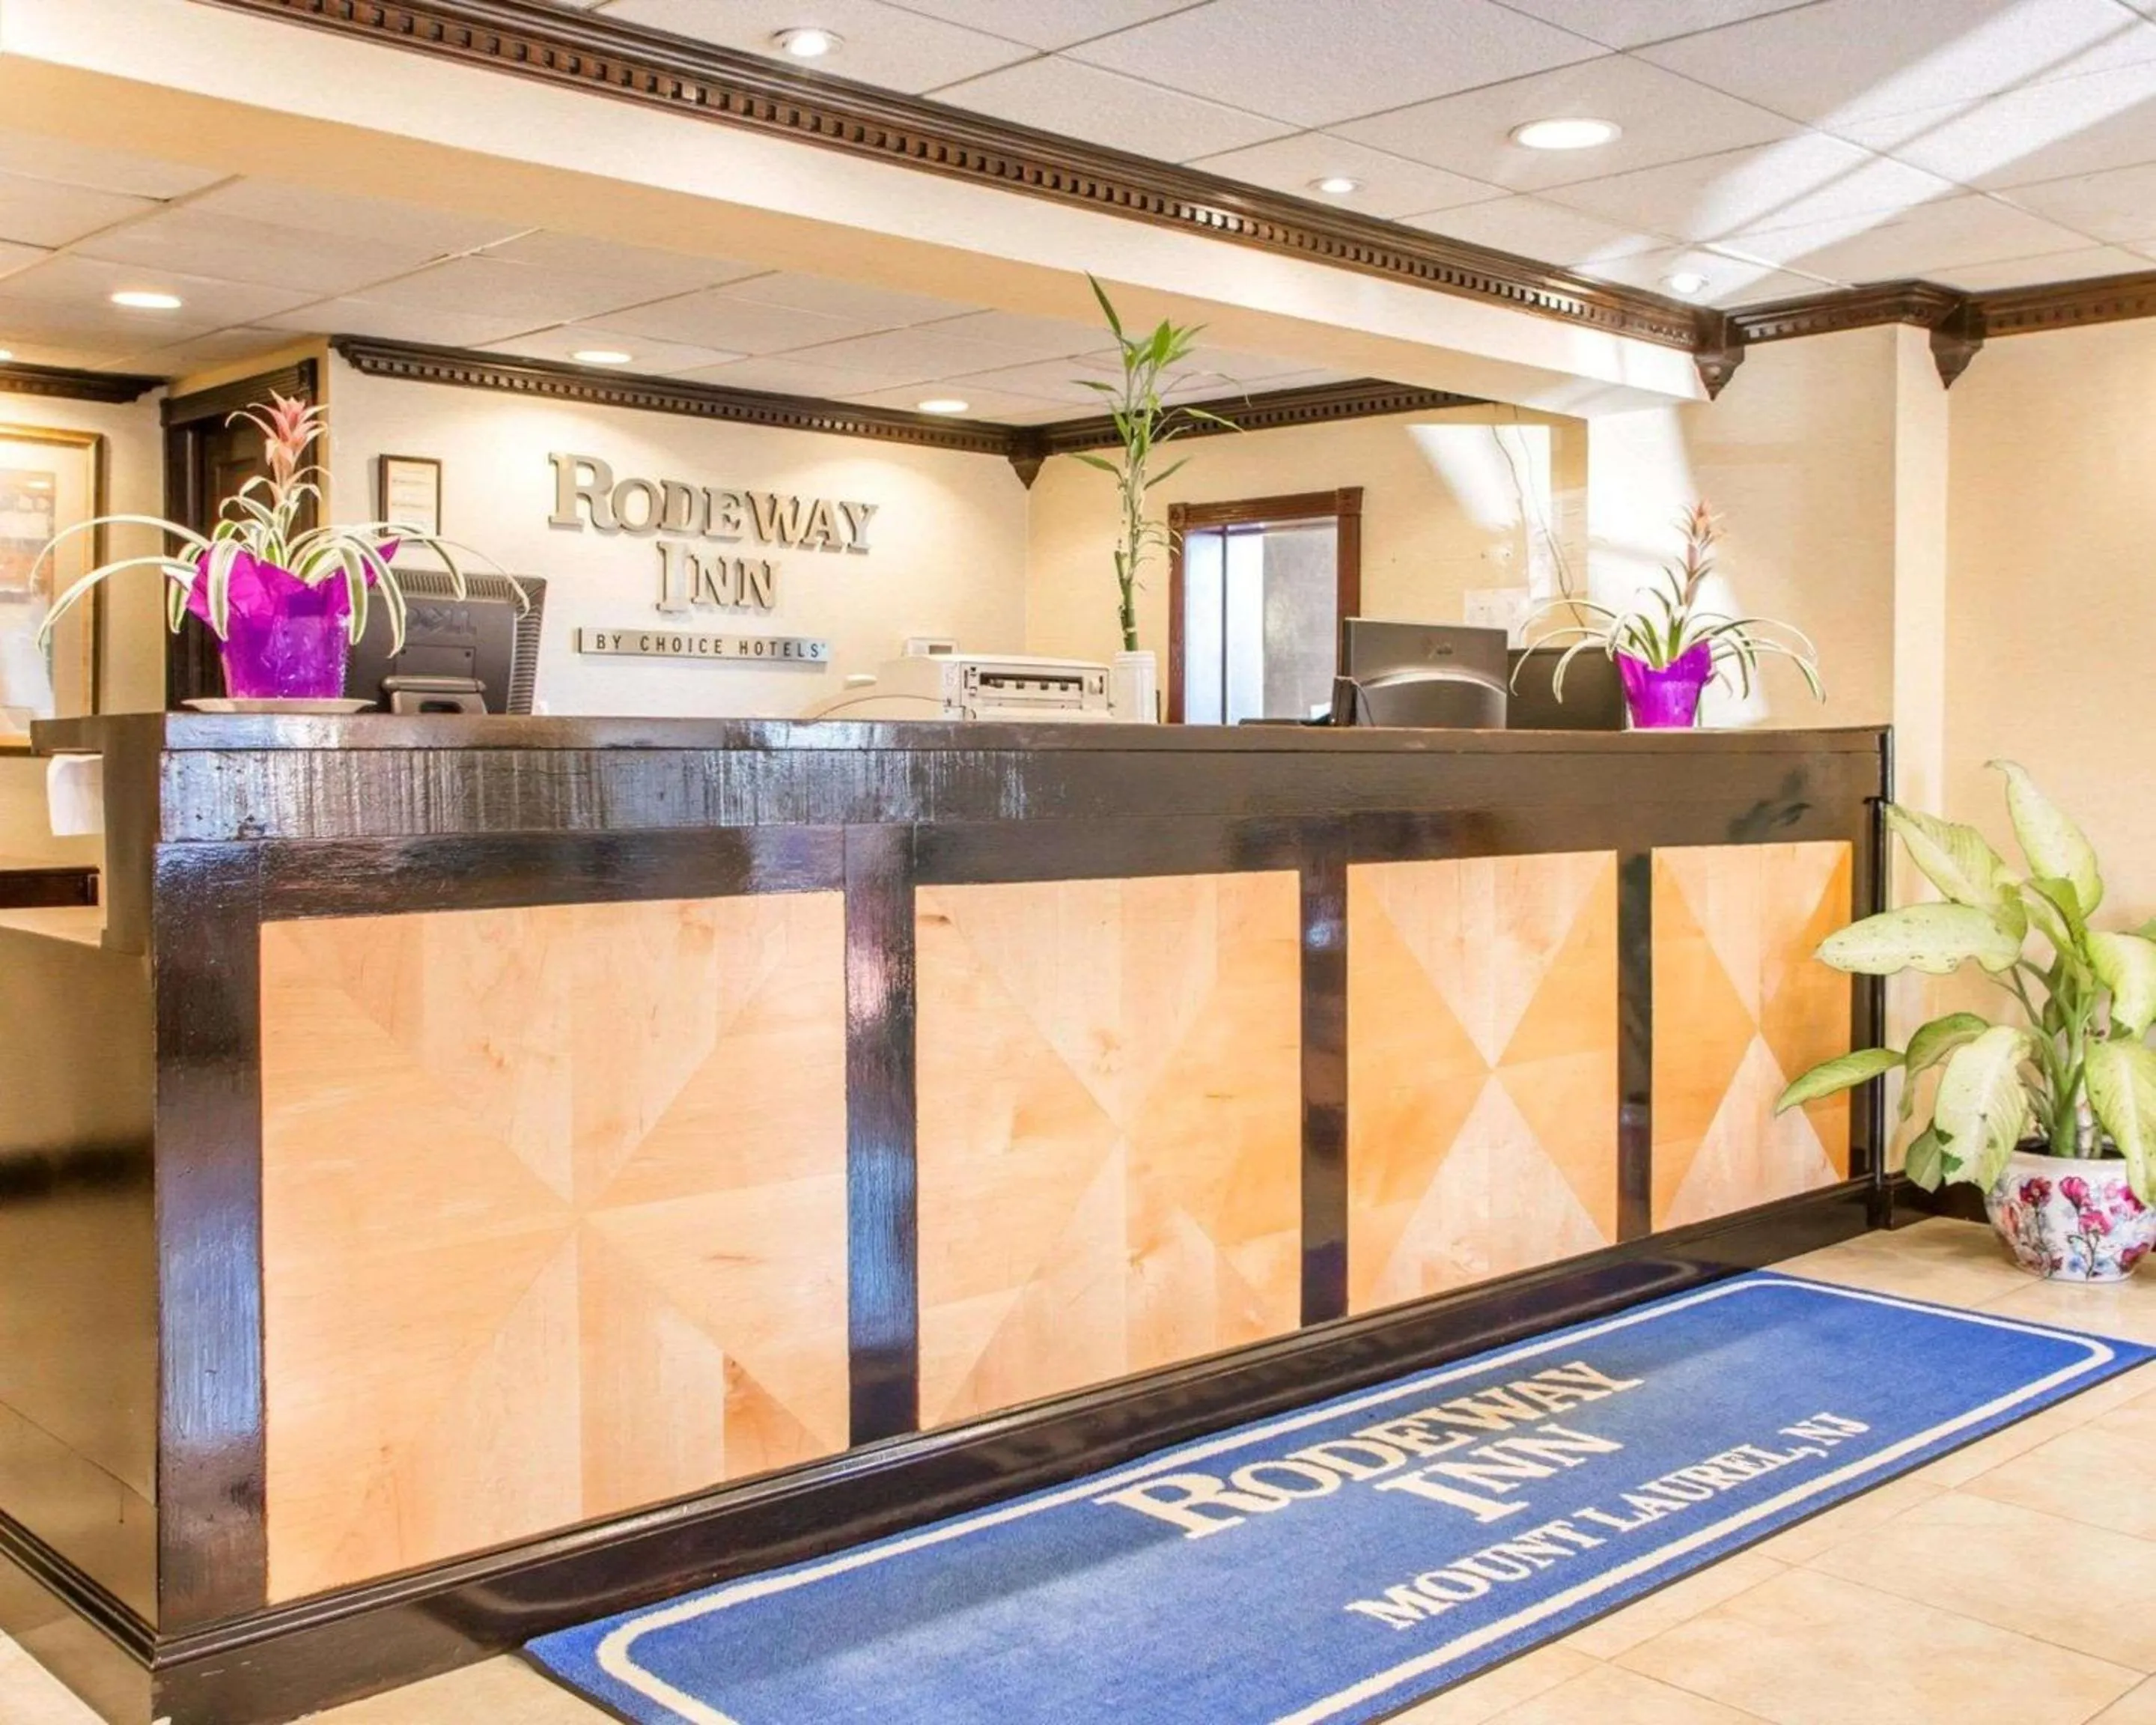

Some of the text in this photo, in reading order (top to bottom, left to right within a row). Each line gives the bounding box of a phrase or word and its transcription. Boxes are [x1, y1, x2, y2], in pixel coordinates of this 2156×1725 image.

[548, 451, 879, 554] RODEWAY
[656, 541, 782, 612] INN
[596, 633, 820, 658] BY CHOICE HOTELS
[1094, 1361, 1645, 1539] RODEWAY
[1373, 1424, 1624, 1523] INN
[1345, 1519, 1607, 1630] MOUNT
